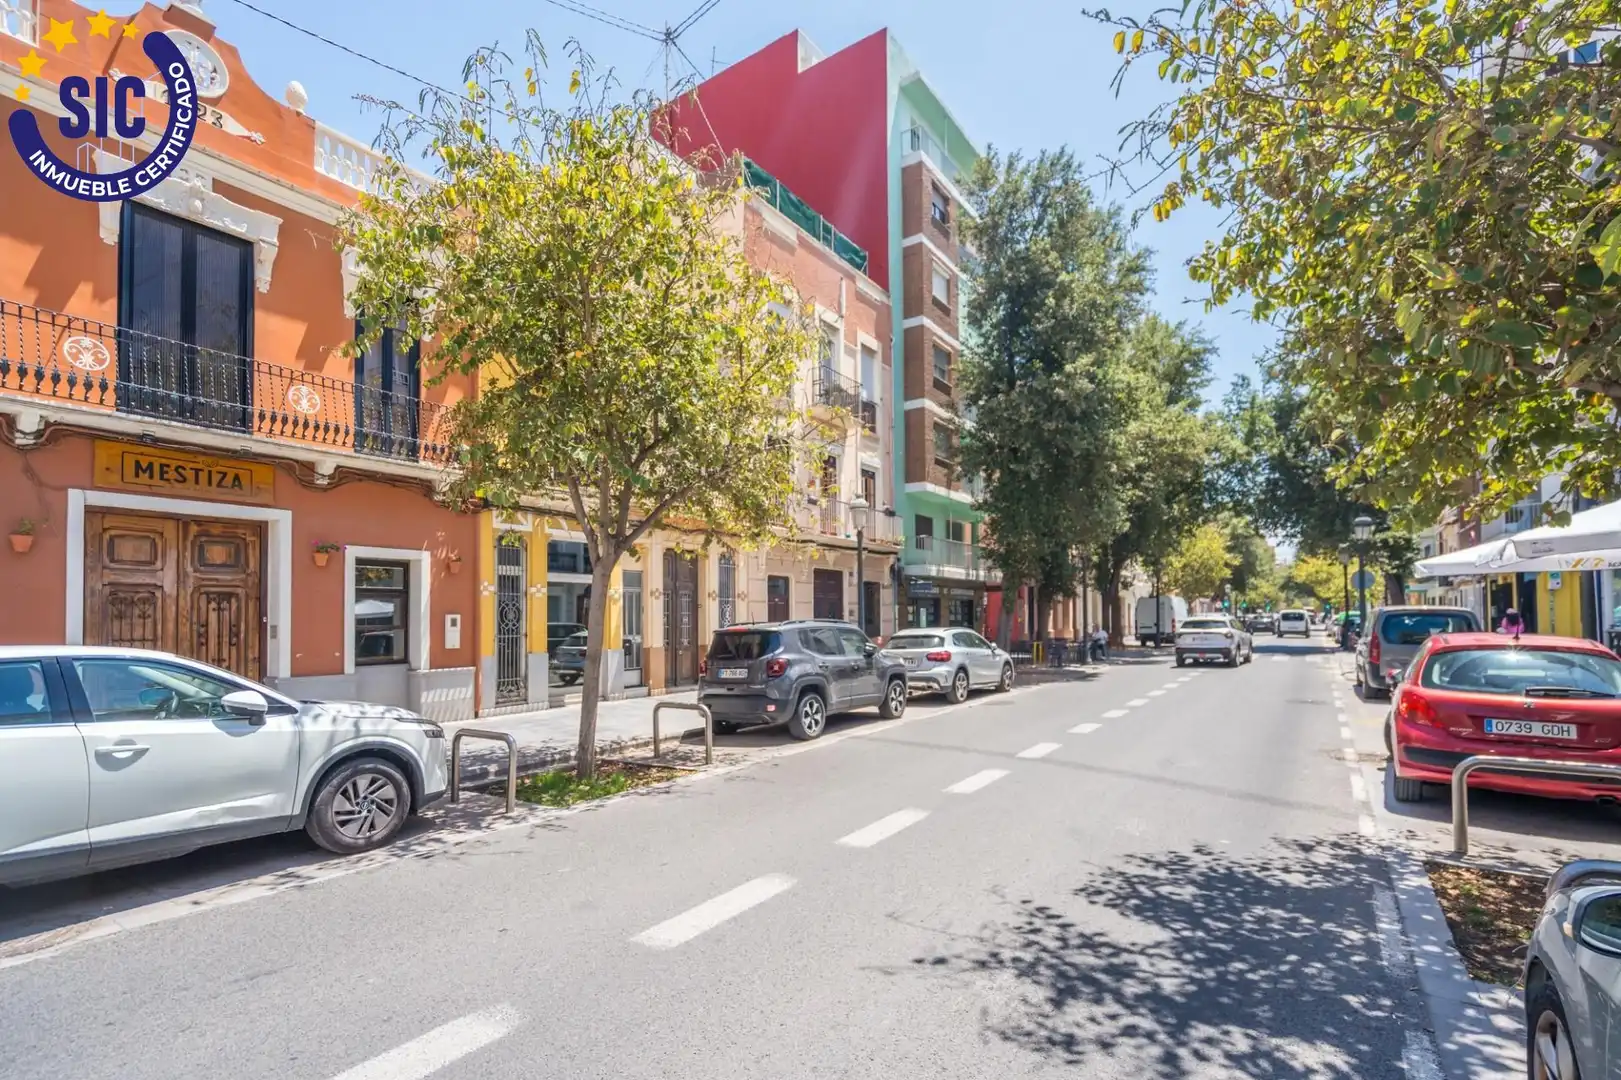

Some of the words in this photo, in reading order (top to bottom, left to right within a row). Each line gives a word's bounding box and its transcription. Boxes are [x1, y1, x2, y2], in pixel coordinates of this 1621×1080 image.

[134, 459, 243, 491] MESTIZA
[1495, 721, 1533, 734] 0739
[1541, 724, 1571, 737] GDH
